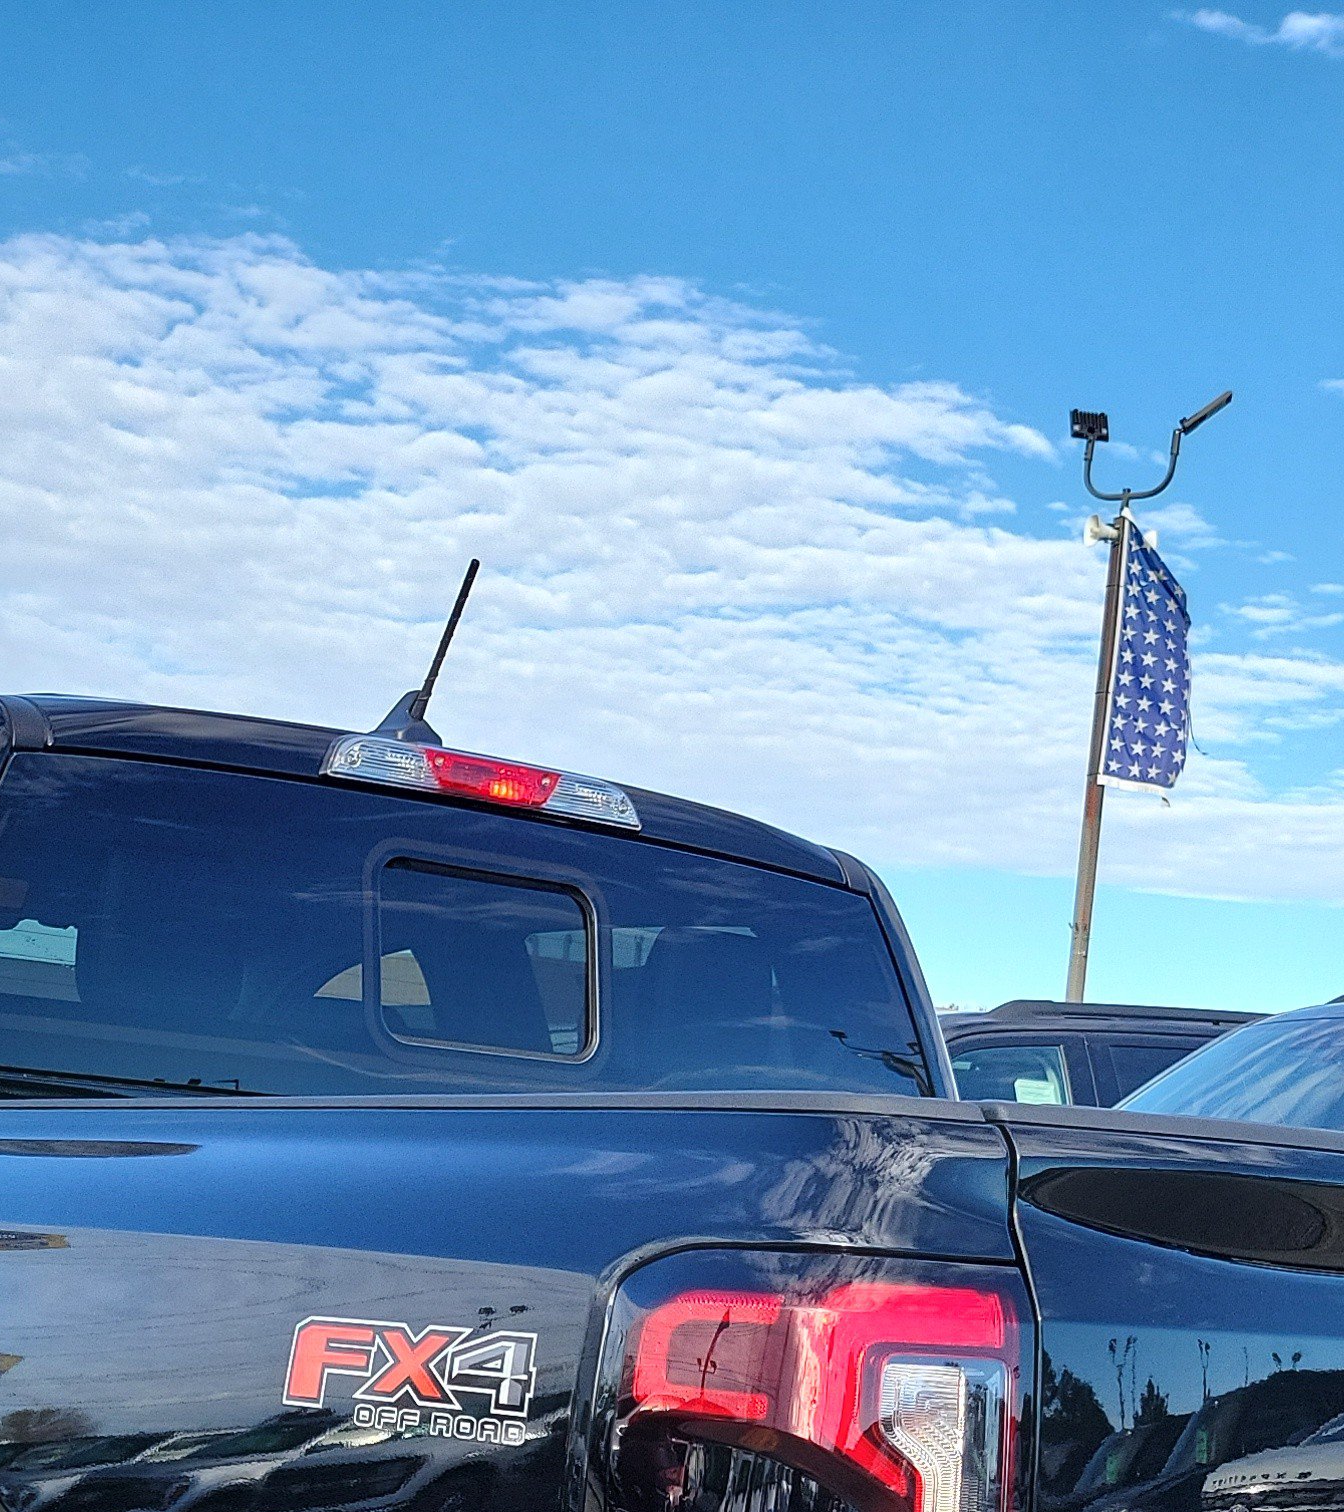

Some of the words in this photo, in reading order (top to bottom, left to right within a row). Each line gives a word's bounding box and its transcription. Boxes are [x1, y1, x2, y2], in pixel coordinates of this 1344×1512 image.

[282, 1315, 538, 1417] FX4
[353, 1403, 420, 1431] OFF
[429, 1411, 526, 1446] ROAD
